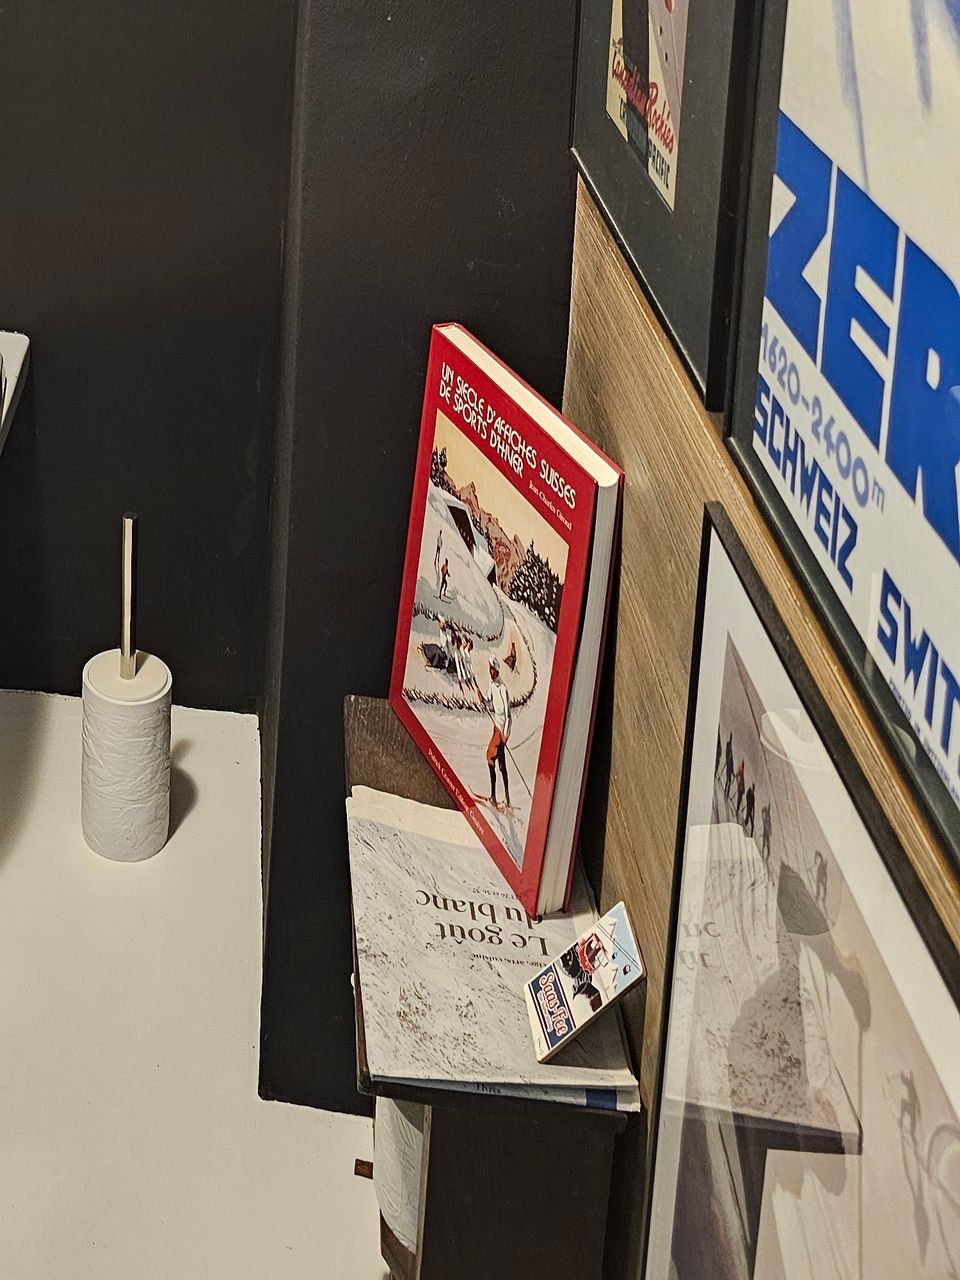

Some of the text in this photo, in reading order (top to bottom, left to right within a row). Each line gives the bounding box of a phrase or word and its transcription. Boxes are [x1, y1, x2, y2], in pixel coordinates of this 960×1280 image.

[439, 381, 524, 479] DE SPORTS D'HIVER
[442, 362, 454, 387] UN
[486, 405, 538, 470] D'AFFICHES
[539, 459, 576, 510] SUISSES
[753, 373, 859, 596] SCHWEIZ
[877, 567, 960, 776] SWIT
[415, 889, 498, 925] blanc
[434, 922, 550, 957] Le goût
[539, 971, 568, 1036] Saas-Fee
